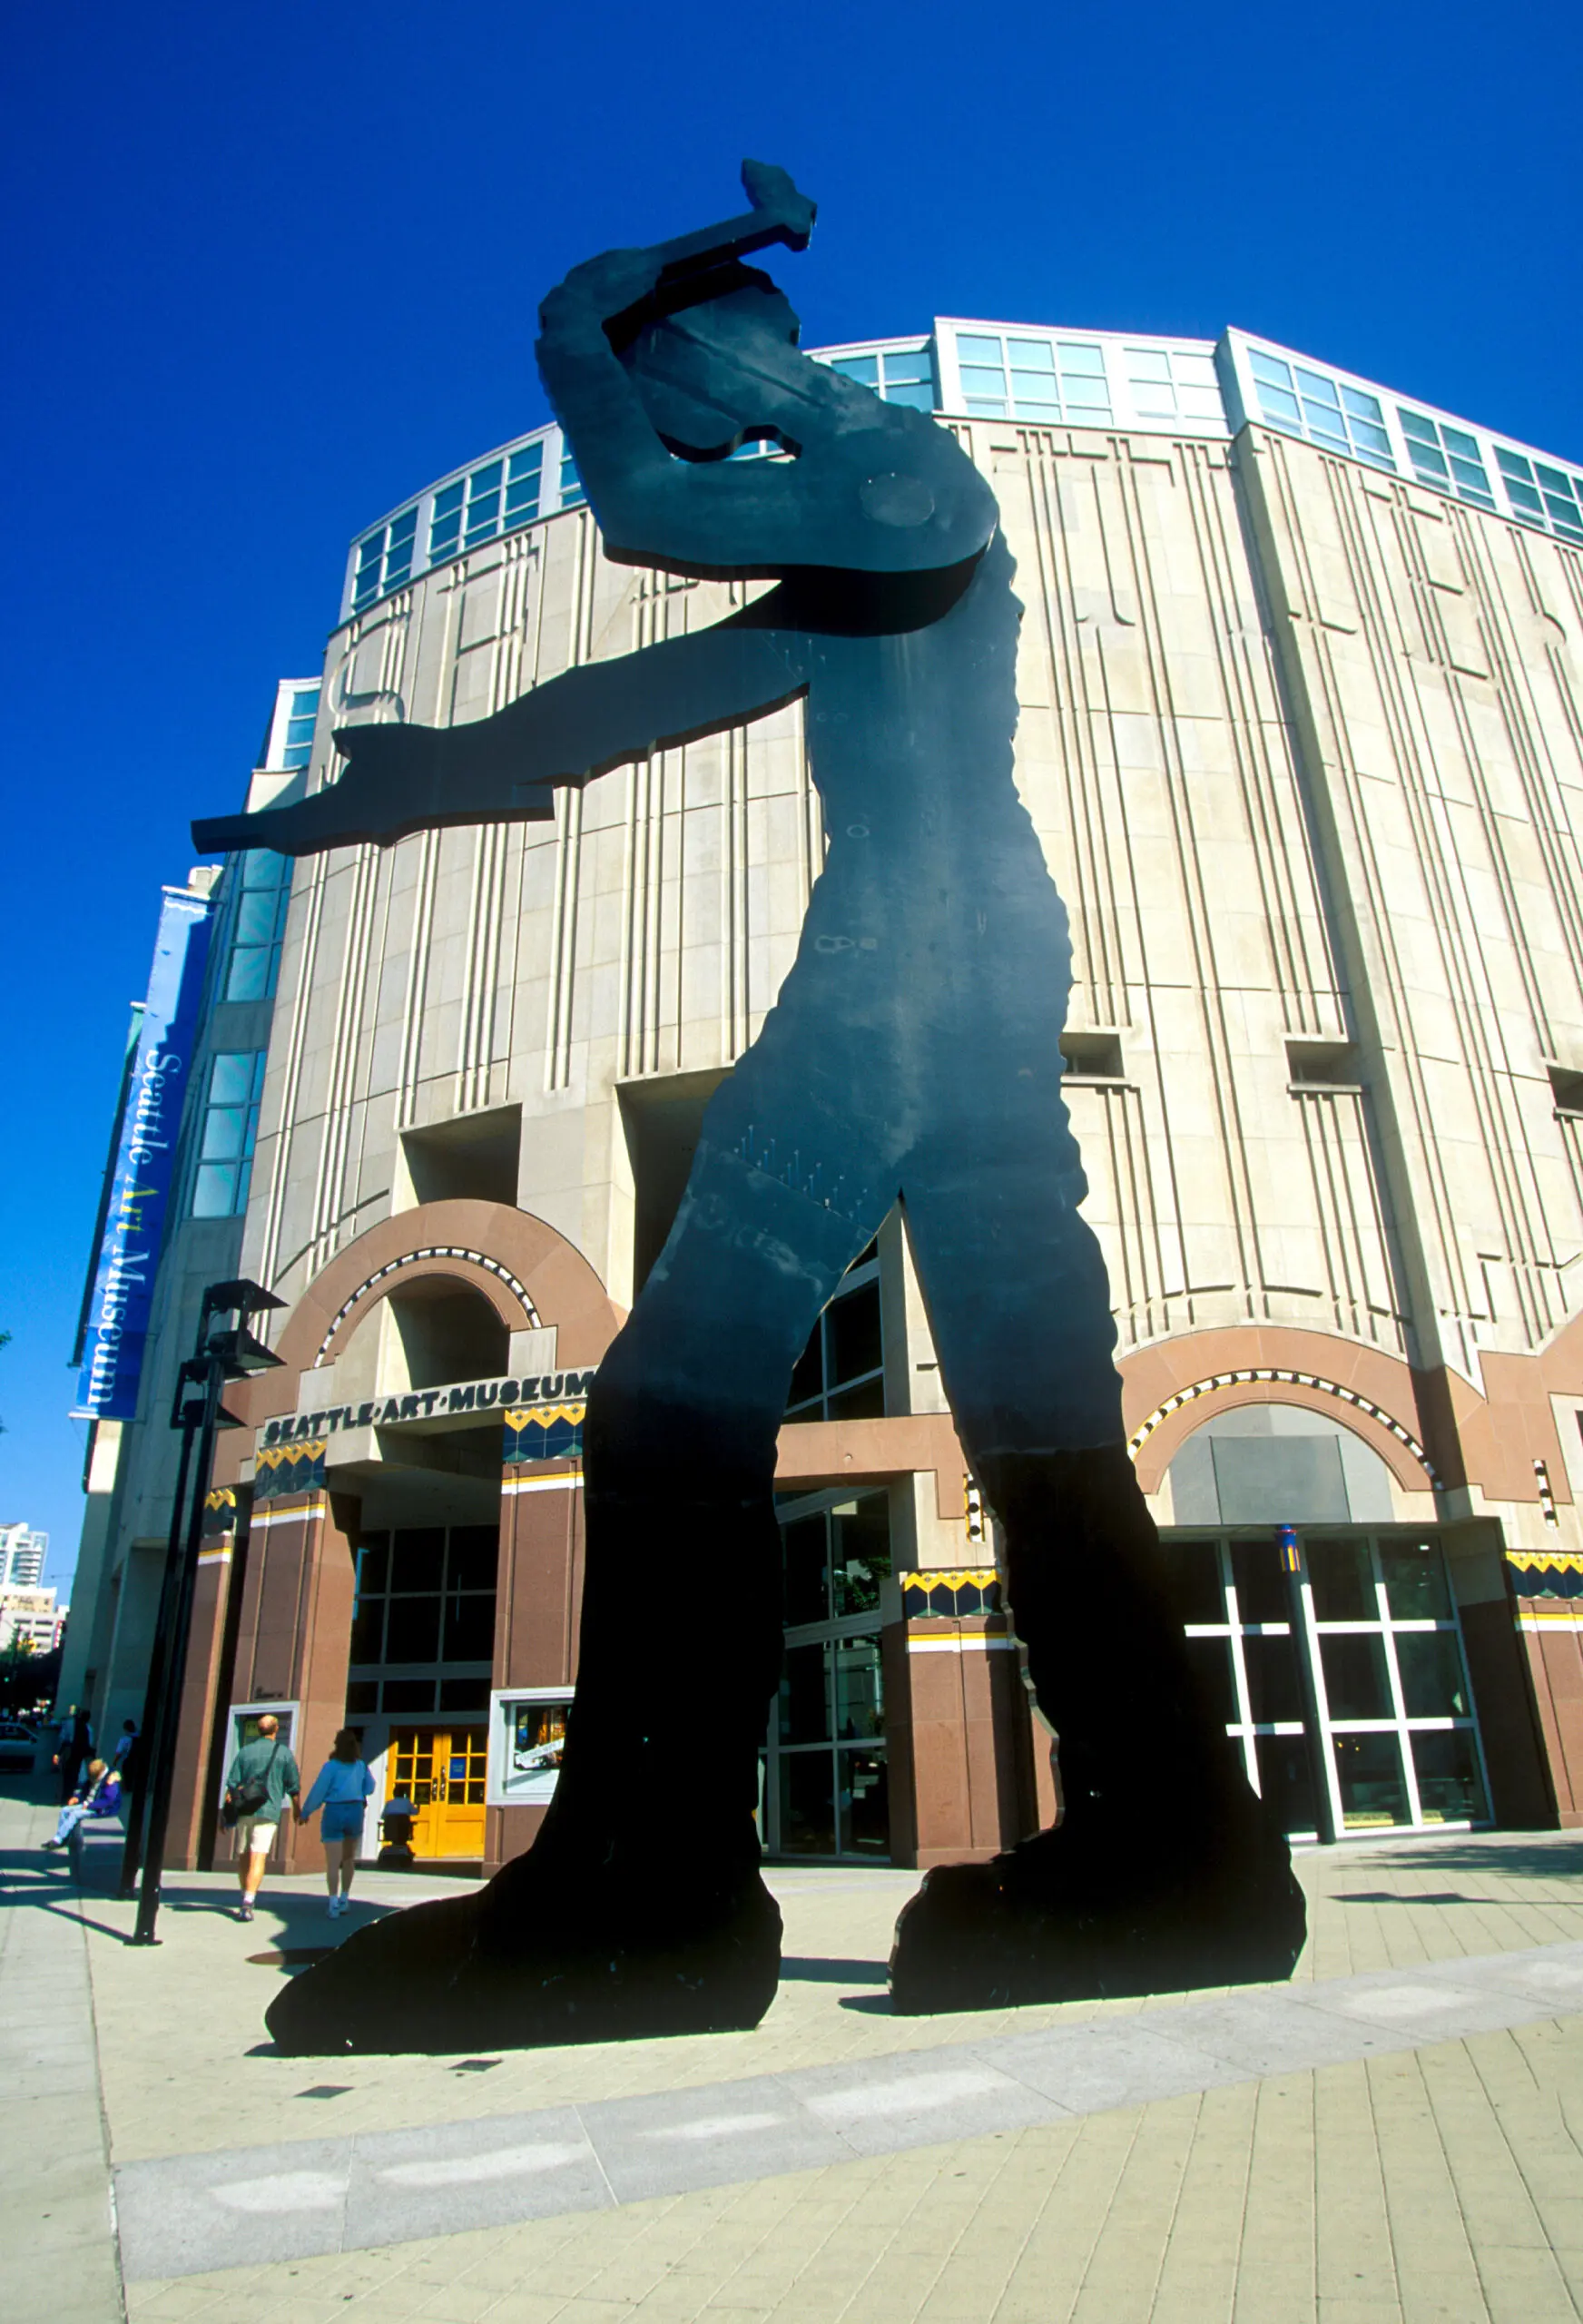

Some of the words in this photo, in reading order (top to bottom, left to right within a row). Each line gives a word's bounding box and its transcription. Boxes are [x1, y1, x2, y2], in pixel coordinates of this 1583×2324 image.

[129, 1049, 182, 1165] Seattle
[117, 1174, 159, 1236] Art
[88, 1245, 149, 1405] Museum
[264, 1402, 374, 1445] SEATTLE
[379, 1391, 441, 1423] ART
[449, 1371, 595, 1412] MUSEUM
